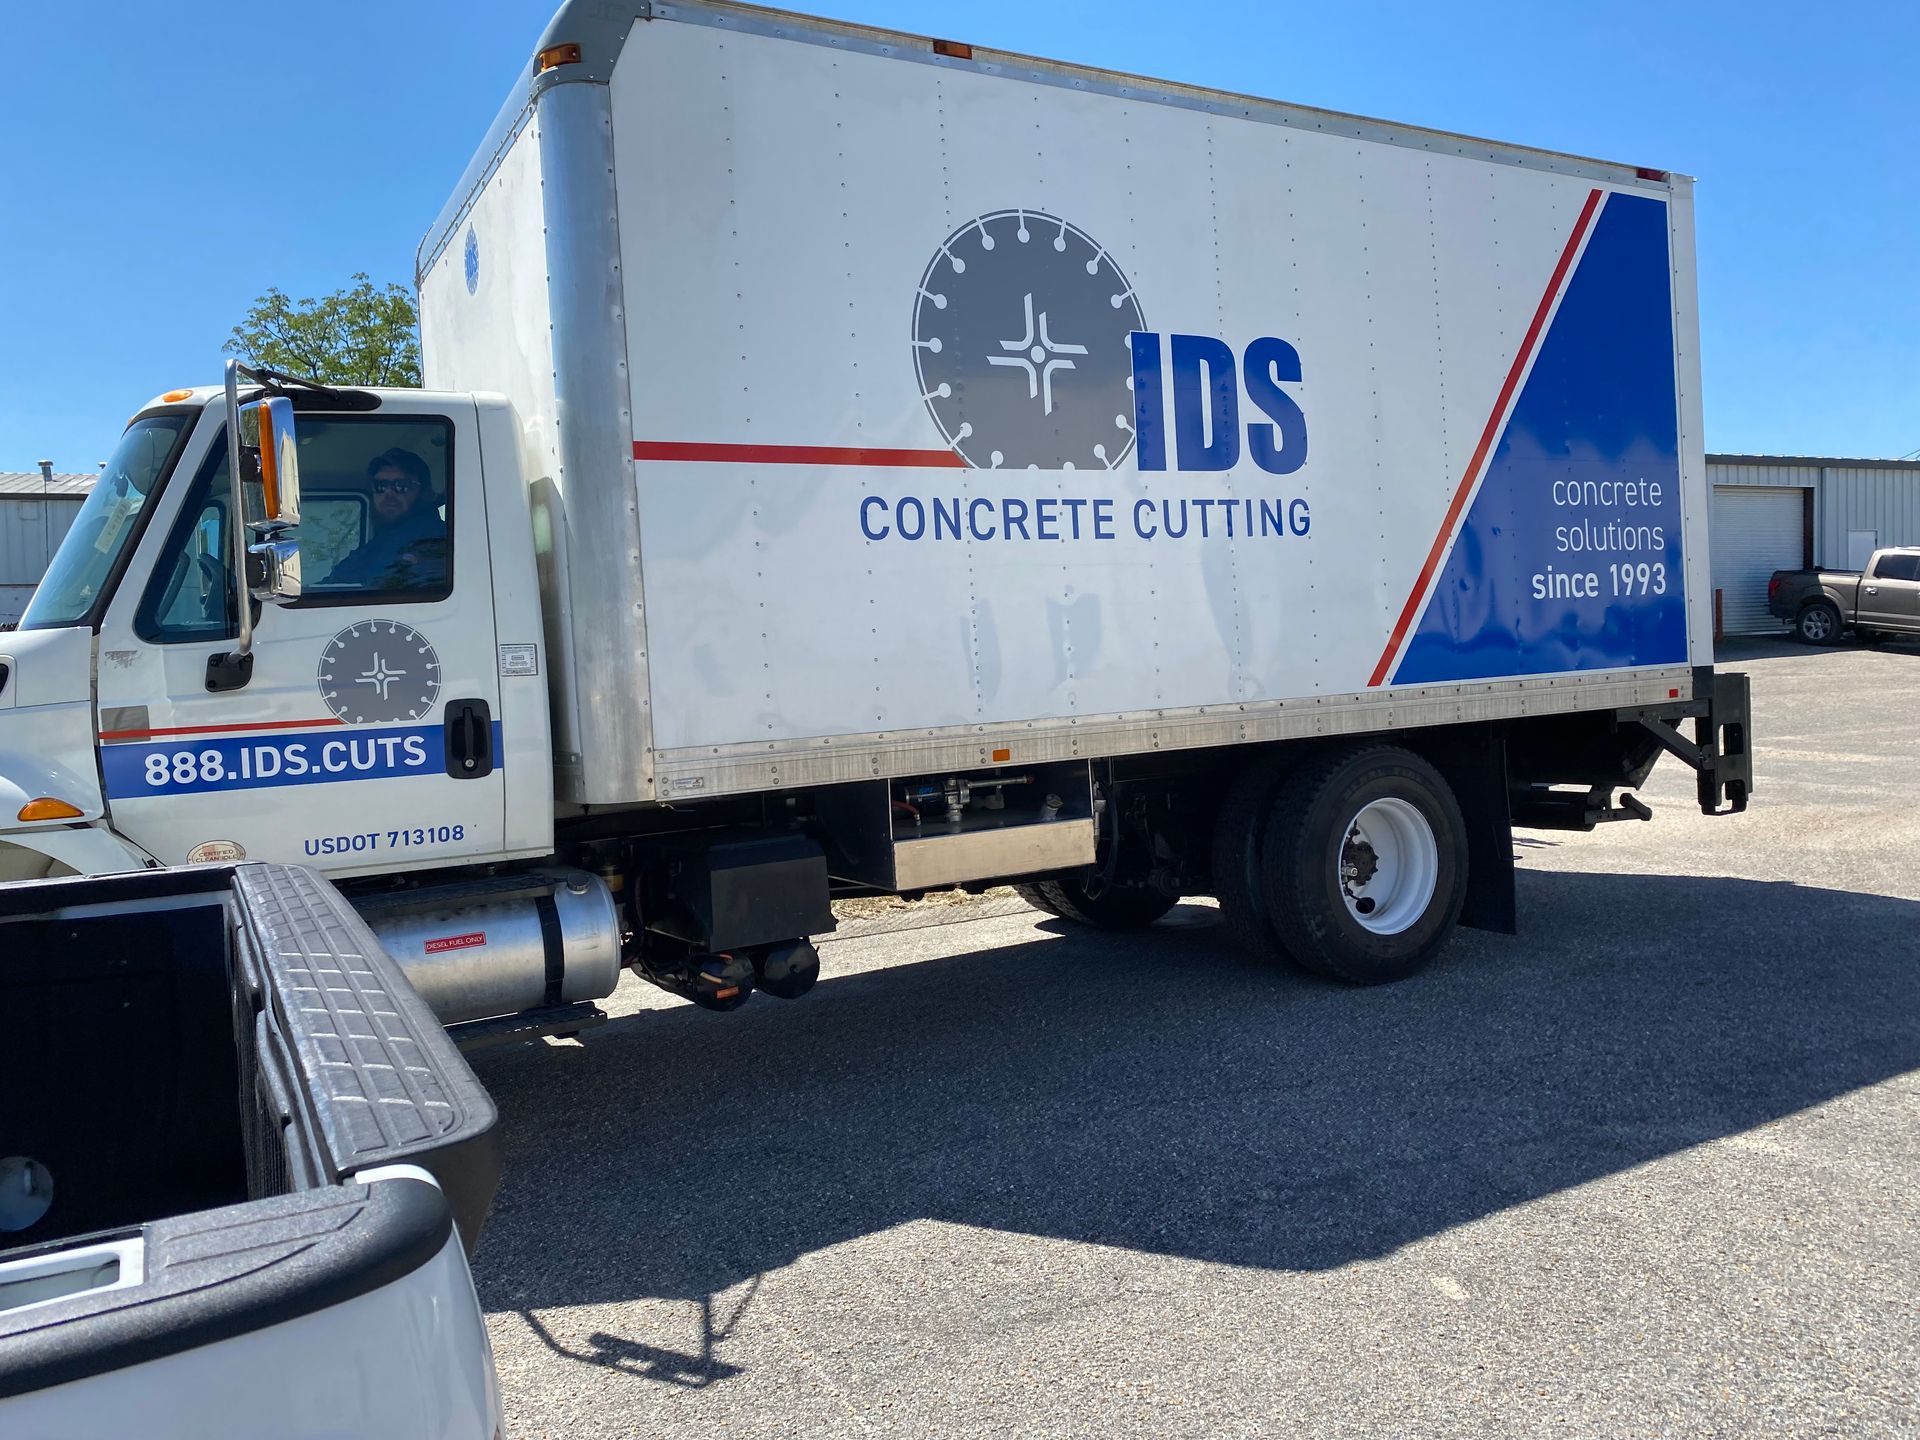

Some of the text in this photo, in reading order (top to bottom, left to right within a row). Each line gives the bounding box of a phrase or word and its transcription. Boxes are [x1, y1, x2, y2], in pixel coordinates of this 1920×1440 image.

[1130, 331, 1309, 475] IDS
[1552, 477, 1663, 507] concrete
[859, 495, 1311, 541] CONCRETE CUTTING
[1555, 517, 1665, 552] solutions
[1531, 561, 1667, 600] since 1993
[144, 735, 427, 787] 888.IDS.CUTS
[198, 849, 234, 858] CERTIFIED
[303, 824, 465, 856] USDOT 713108
[426, 935, 483, 950] DIESEL FUEL ONLY
